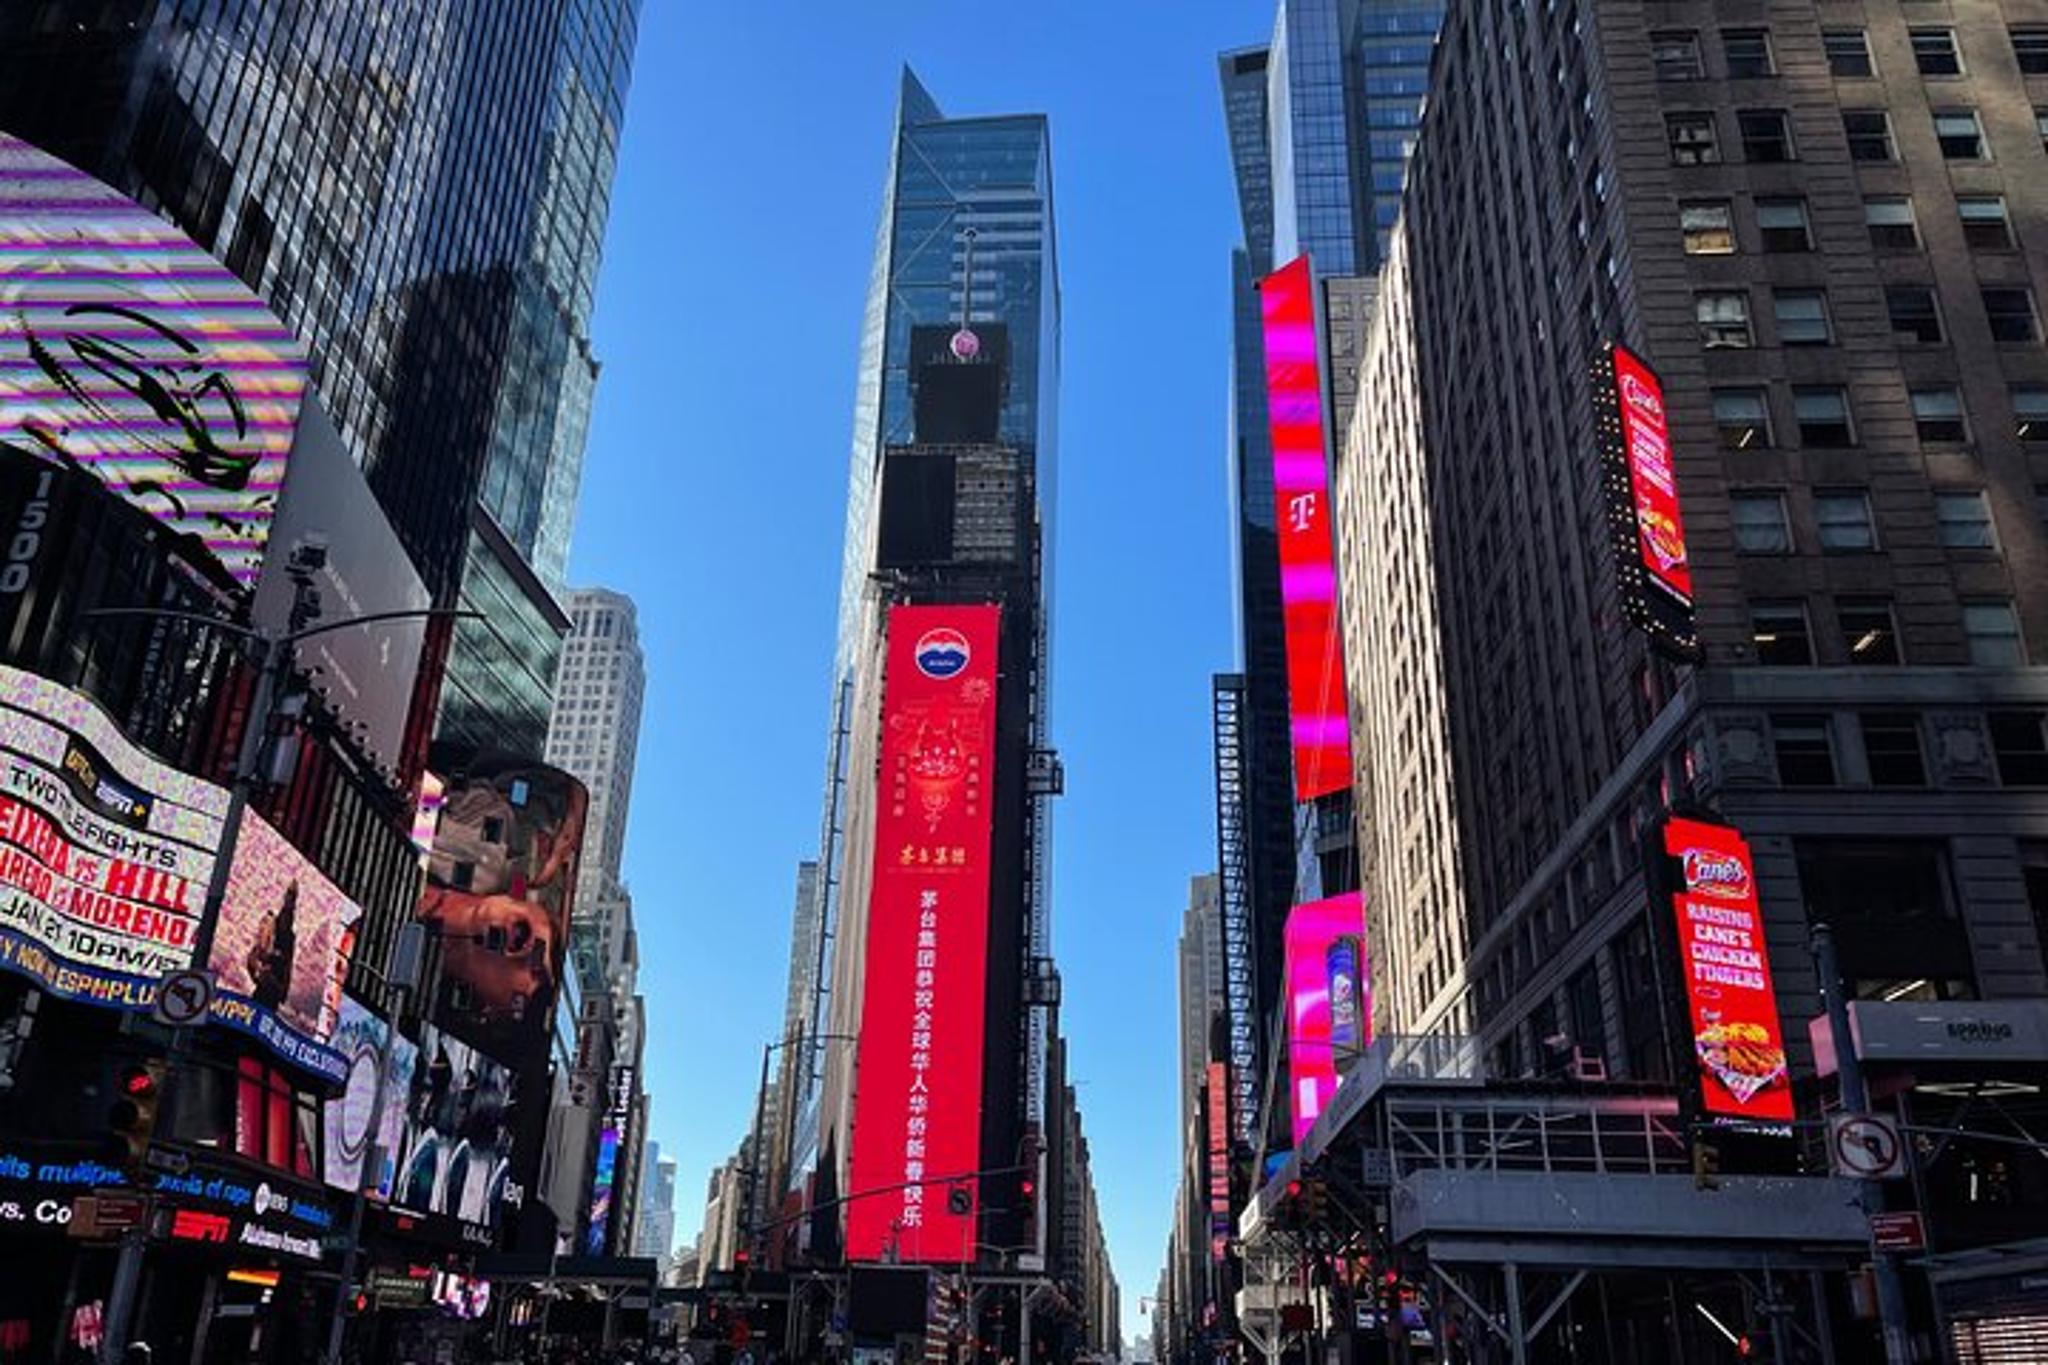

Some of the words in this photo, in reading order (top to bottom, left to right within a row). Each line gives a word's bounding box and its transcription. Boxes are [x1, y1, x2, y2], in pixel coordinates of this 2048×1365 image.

[0, 471, 51, 592] 1500
[10, 765, 57, 805] TWO
[85, 822, 177, 868] FIGHTS
[105, 858, 188, 913] HILL
[69, 886, 189, 945] MORENO
[35, 1199, 72, 1224] Co
